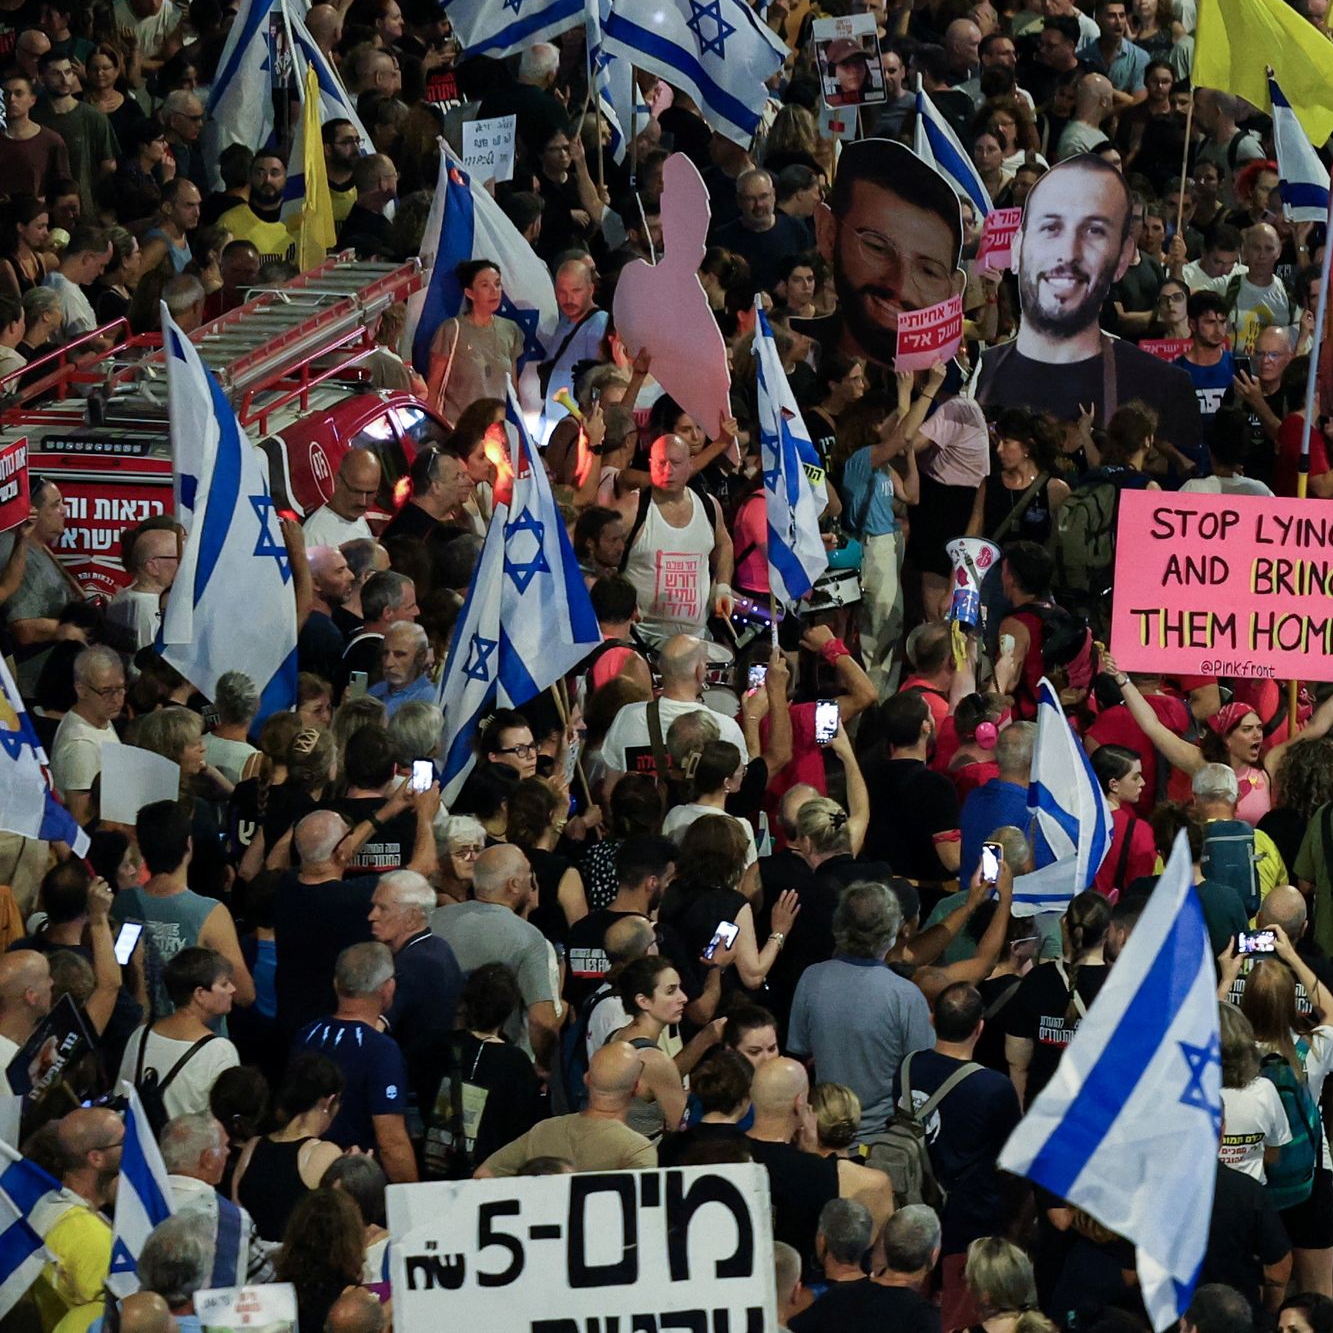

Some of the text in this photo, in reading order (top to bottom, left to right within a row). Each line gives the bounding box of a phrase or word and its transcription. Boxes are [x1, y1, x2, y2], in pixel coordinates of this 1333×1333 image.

[903, 320, 960, 349] זועק אלי
[1150, 507, 1240, 541] STOP
[665, 573, 697, 588] דורש
[1161, 553, 1229, 588] AND
[1129, 607, 1236, 650] THEM
